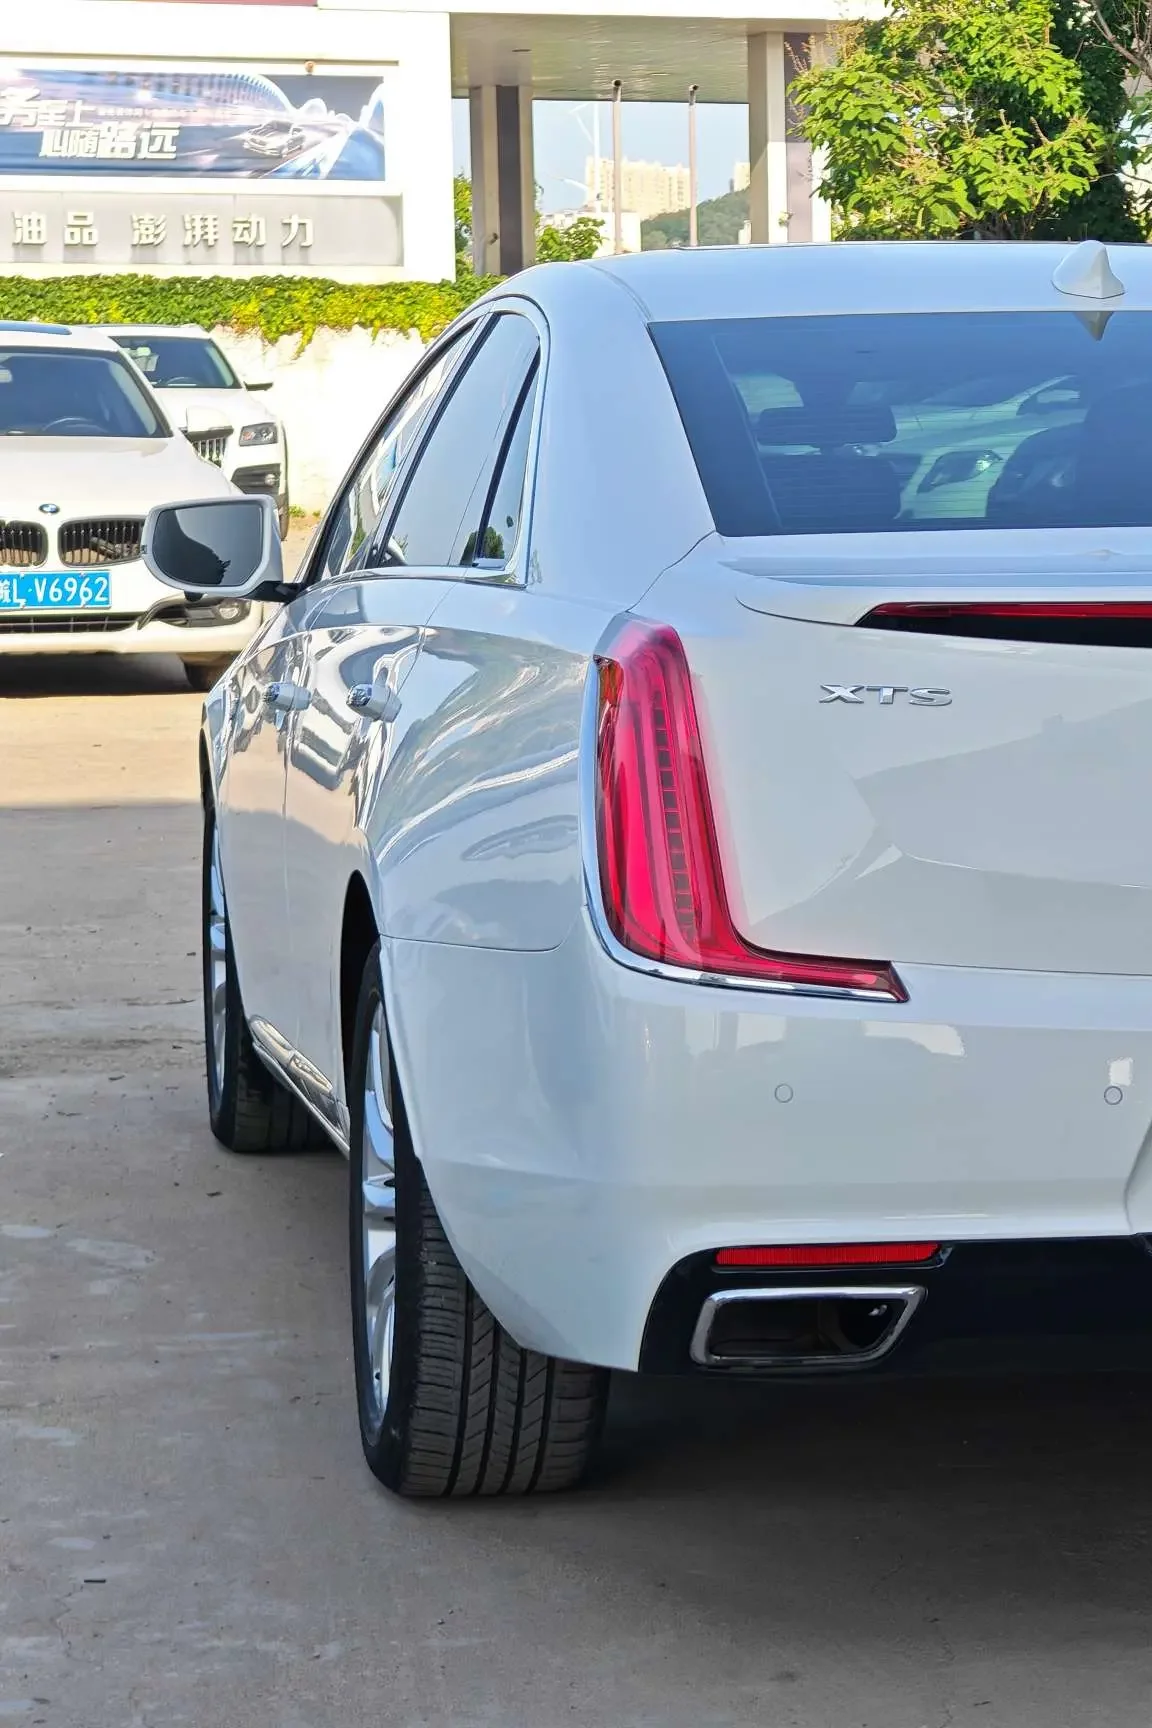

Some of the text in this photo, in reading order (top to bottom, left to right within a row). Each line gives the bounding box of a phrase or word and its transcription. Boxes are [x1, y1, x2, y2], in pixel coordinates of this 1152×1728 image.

[12, 211, 313, 248] 油品 澎湃动力
[819, 684, 952, 706] XTS
